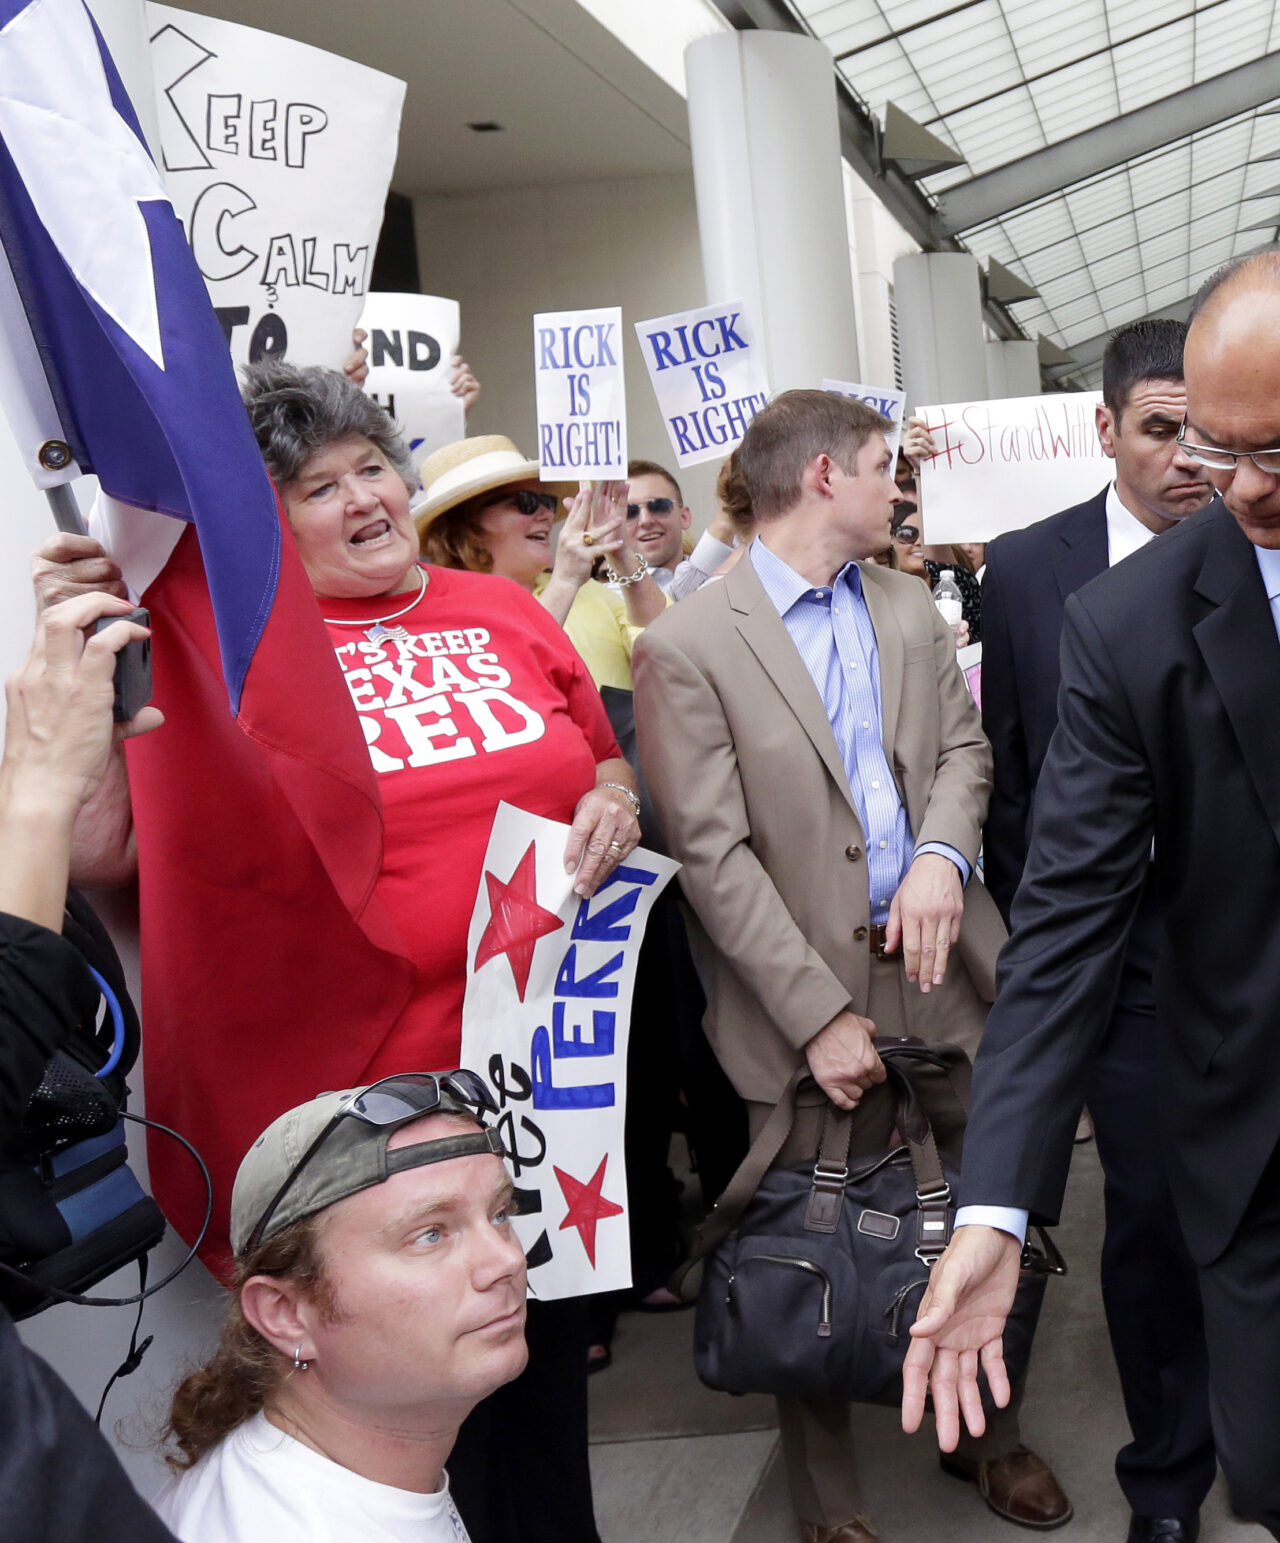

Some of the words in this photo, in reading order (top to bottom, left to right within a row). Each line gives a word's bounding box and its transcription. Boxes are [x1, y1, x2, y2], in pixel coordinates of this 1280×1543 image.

[190, 182, 369, 296] CALM
[538, 323, 617, 370] RICK
[646, 312, 749, 371] RICK
[567, 373, 591, 417] IS
[691, 361, 727, 403] IS
[540, 420, 622, 467] RIGHT!
[393, 627, 491, 661] KEEP
[344, 652, 512, 711] EXAS
[358, 687, 546, 774] RED
